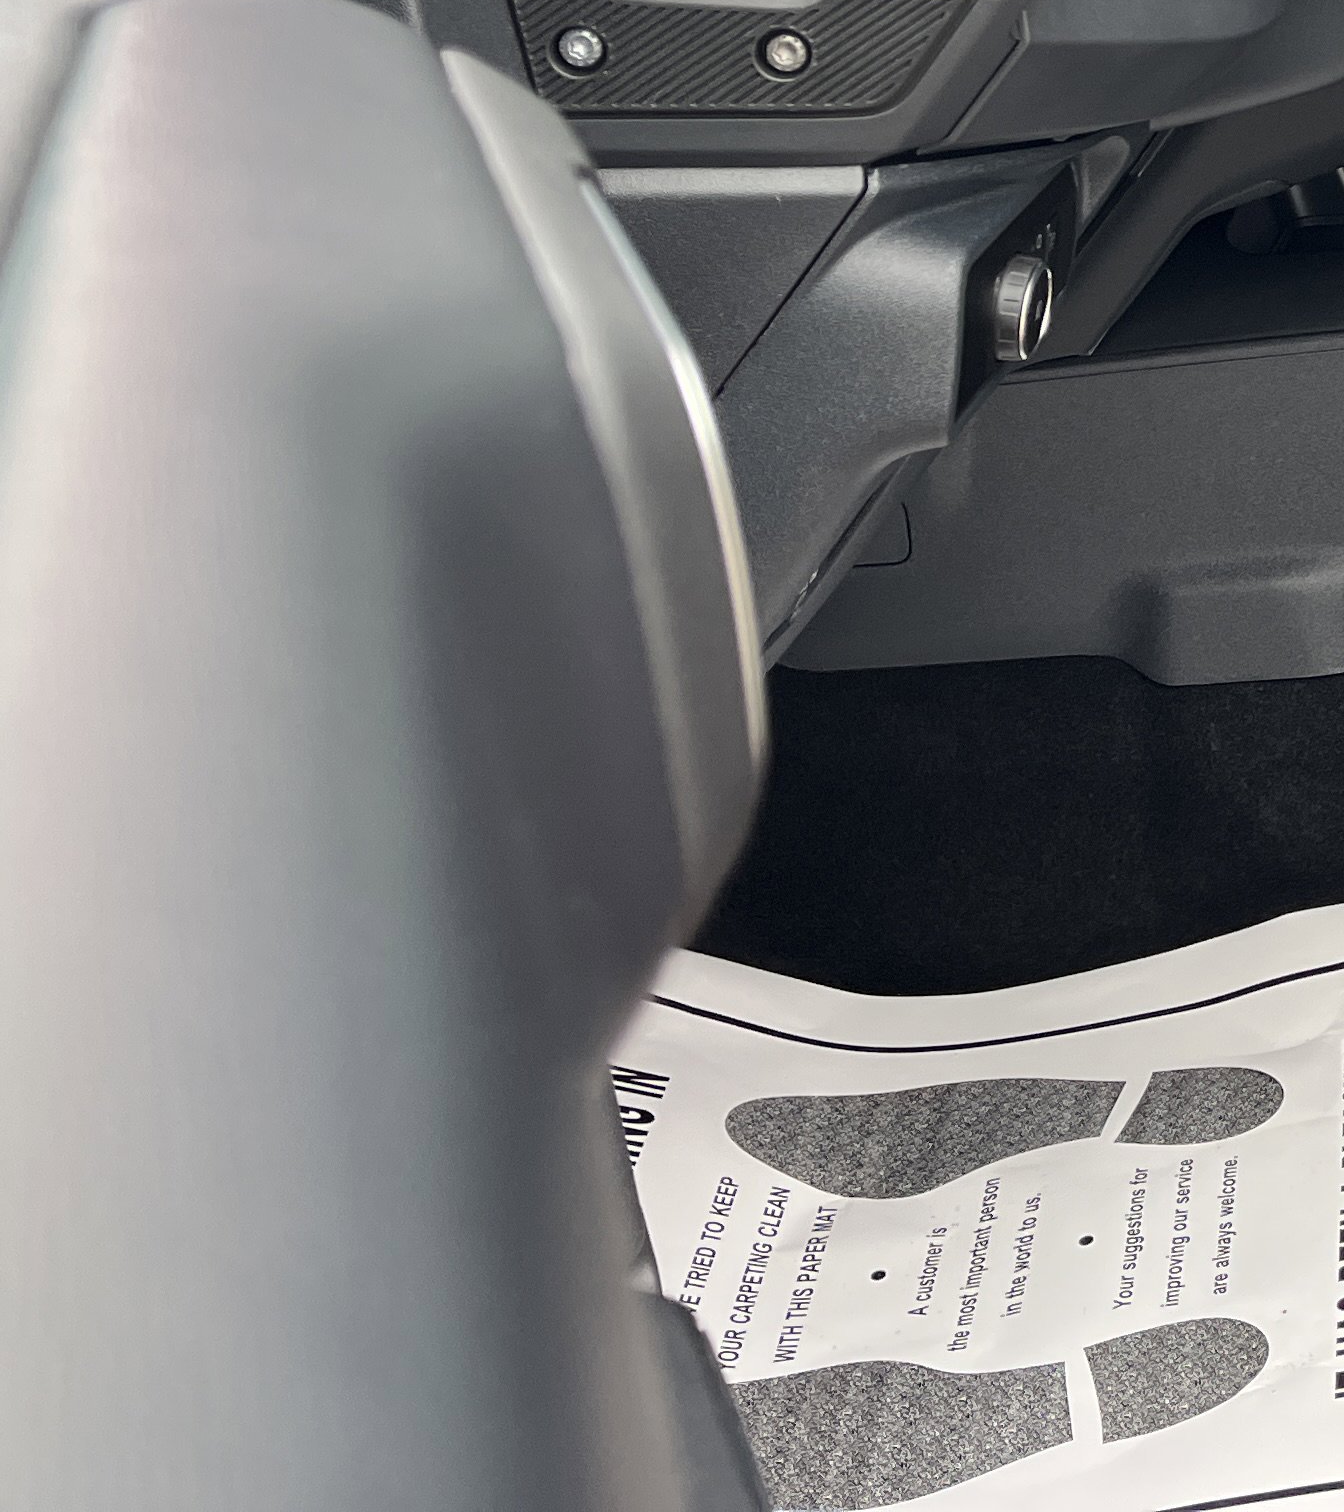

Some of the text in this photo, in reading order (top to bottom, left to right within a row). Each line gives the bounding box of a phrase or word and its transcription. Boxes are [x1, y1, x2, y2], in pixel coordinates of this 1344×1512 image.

[701, 1221, 725, 1243] TO
[710, 1176, 740, 1217] KEEP
[946, 1177, 1001, 1352] the most important person
[1000, 1193, 1042, 1318] in the world to us.
[1112, 1168, 1149, 1311] Your suggestions for
[1160, 1158, 1194, 1308] improving our service
[1212, 1155, 1240, 1296] are always welcome.
[683, 1247, 716, 1291] TRIED
[717, 1186, 791, 1369] YOUR CARPETING CLEAN
[774, 1206, 839, 1364] WITH THIS PAPER MAT
[908, 1227, 948, 1316] A customer is
